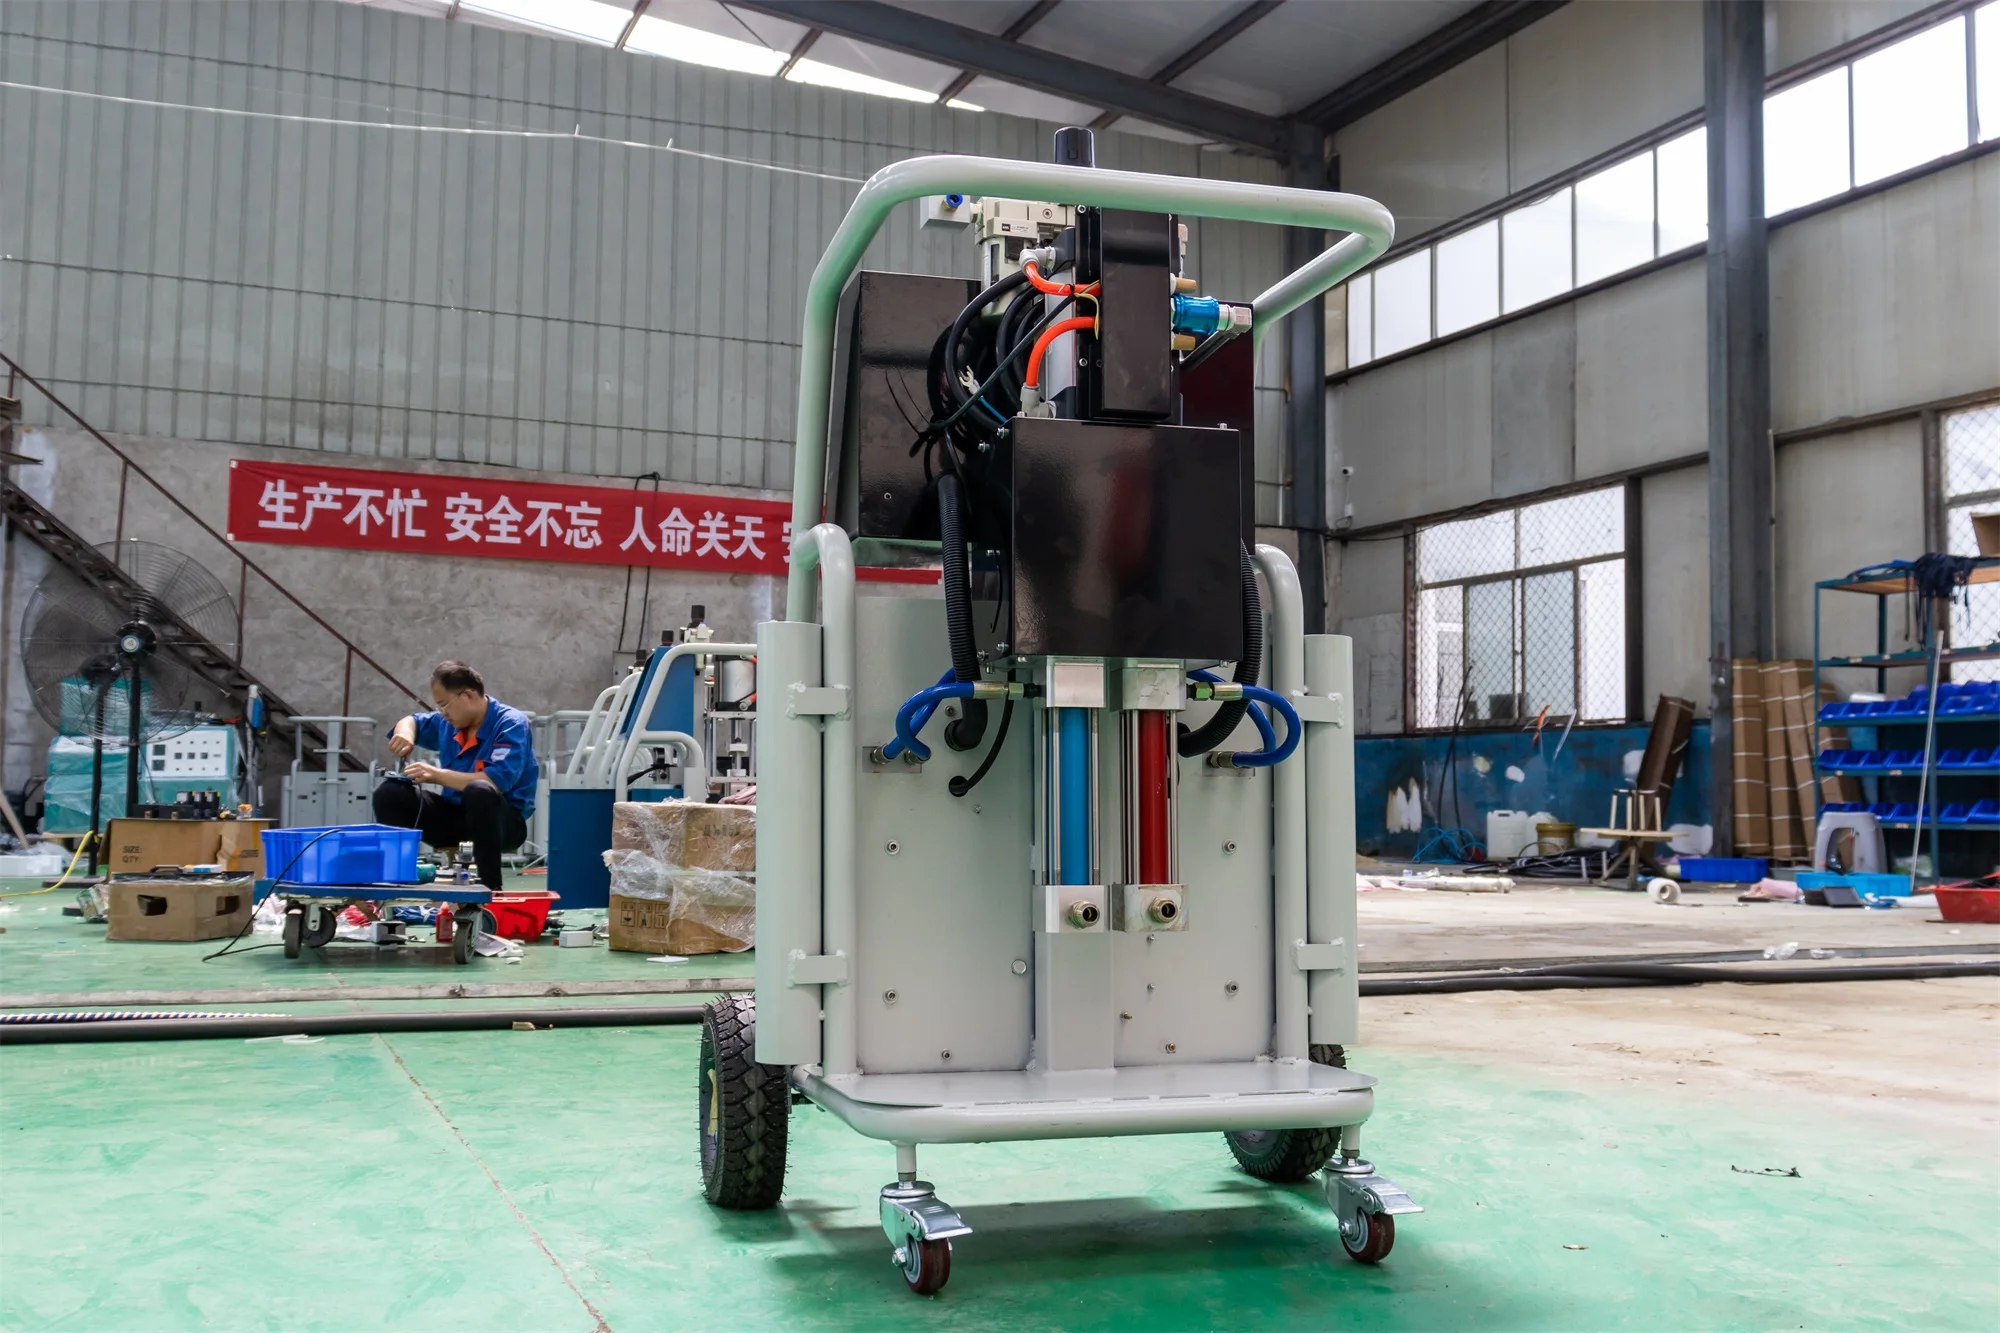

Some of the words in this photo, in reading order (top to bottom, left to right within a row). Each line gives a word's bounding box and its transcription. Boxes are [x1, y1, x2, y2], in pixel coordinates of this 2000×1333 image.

[258, 479, 428, 538] 生产不忙
[444, 492, 602, 549] 安全不忘
[619, 506, 767, 560] 人命关天
